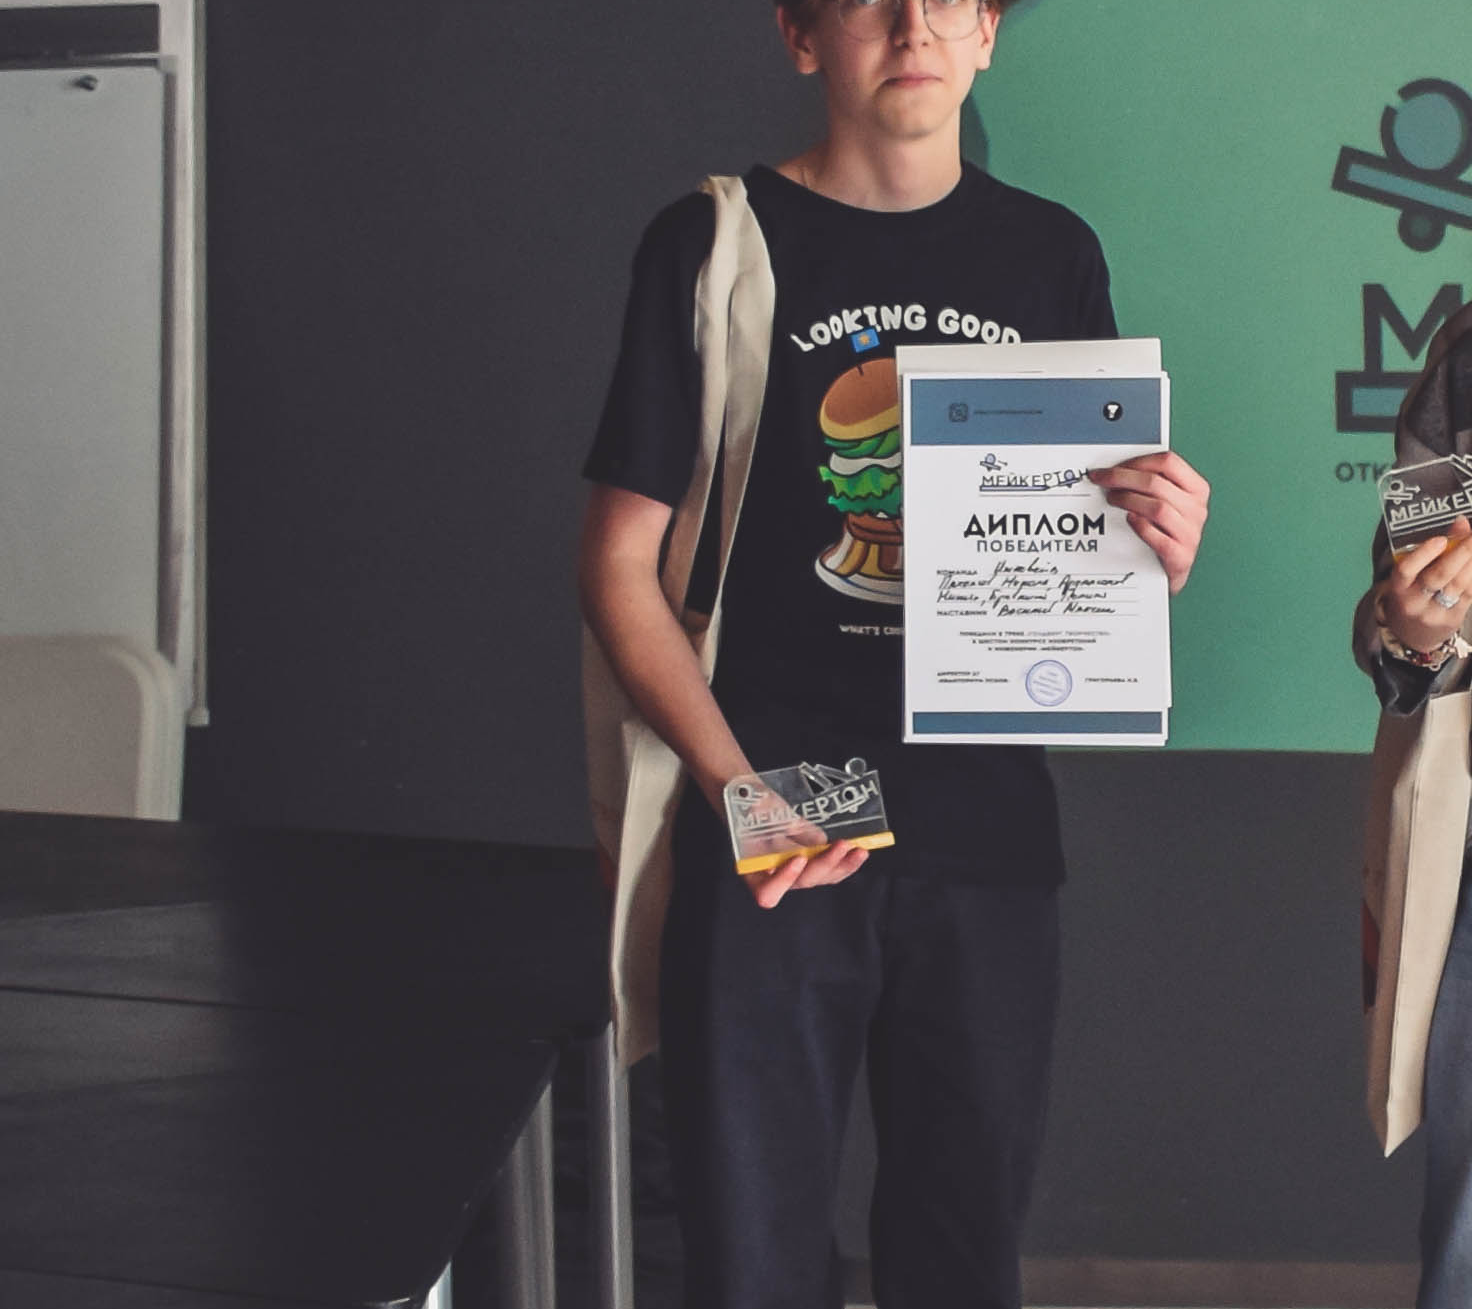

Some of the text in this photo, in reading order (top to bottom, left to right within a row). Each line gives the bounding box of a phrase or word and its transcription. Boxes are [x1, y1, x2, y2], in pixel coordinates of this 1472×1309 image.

[791, 304, 1021, 352] LOOKING GOOD
[964, 513, 1105, 538] ДИПЛОМ
[977, 539, 1098, 553] ПОБЕДИТЕЛЯ
